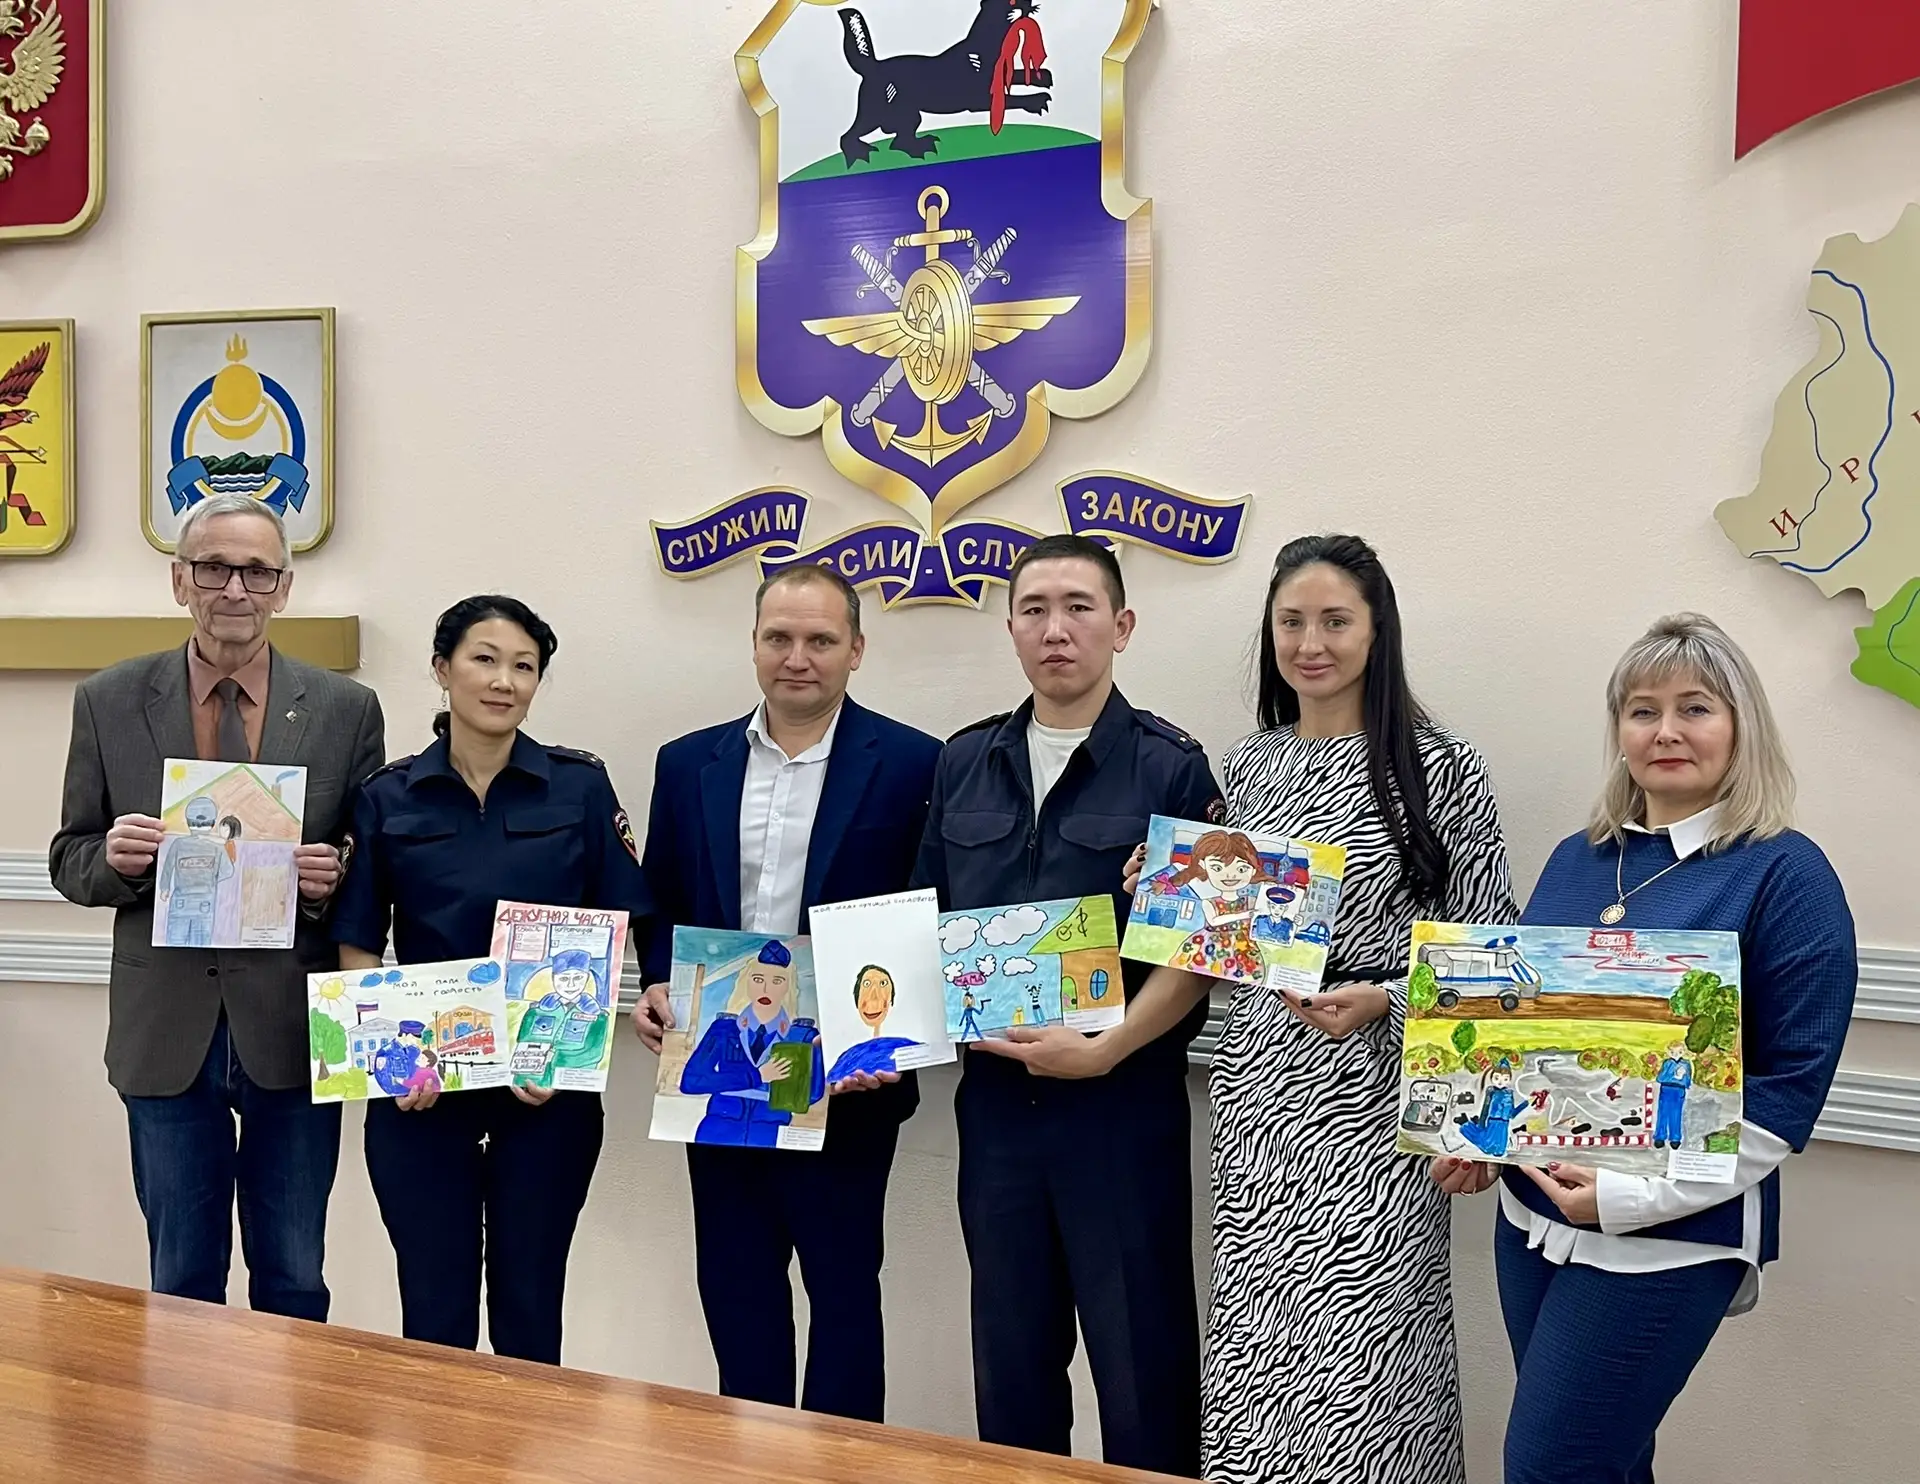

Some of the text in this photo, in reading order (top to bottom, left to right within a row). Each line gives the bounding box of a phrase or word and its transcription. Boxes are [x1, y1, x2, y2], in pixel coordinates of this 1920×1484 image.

[667, 502, 798, 566] СЛУЖИМ
[816, 541, 912, 577] СИИ
[958, 537, 1026, 570] СЛУ
[1081, 490, 1224, 546] ЗАКОНУ
[496, 908, 615, 928] ДЕЖУРНАЯ ЧАСТЬ
